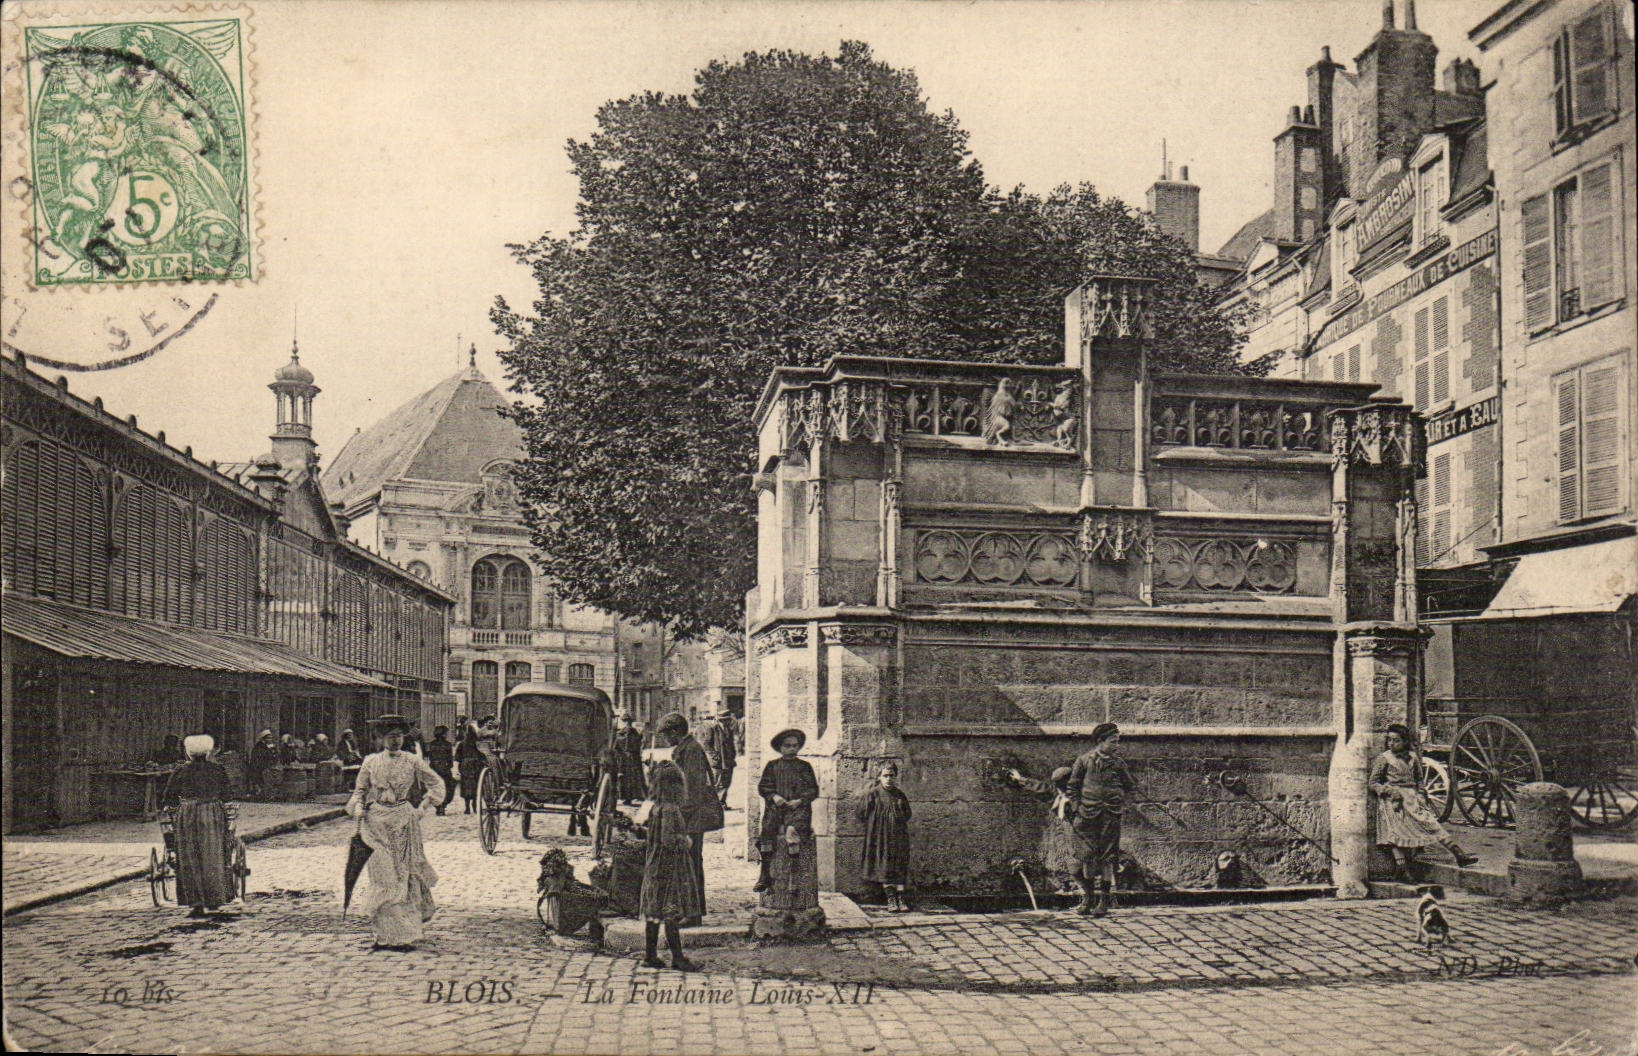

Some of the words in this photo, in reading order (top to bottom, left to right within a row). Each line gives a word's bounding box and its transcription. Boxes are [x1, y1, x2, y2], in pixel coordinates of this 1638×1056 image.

[1430, 261, 1445, 283] DE
[1447, 231, 1497, 273] CUISINE
[1445, 418, 1457, 437] ET
[1459, 414, 1467, 432] A
[1470, 398, 1498, 428] EAU
